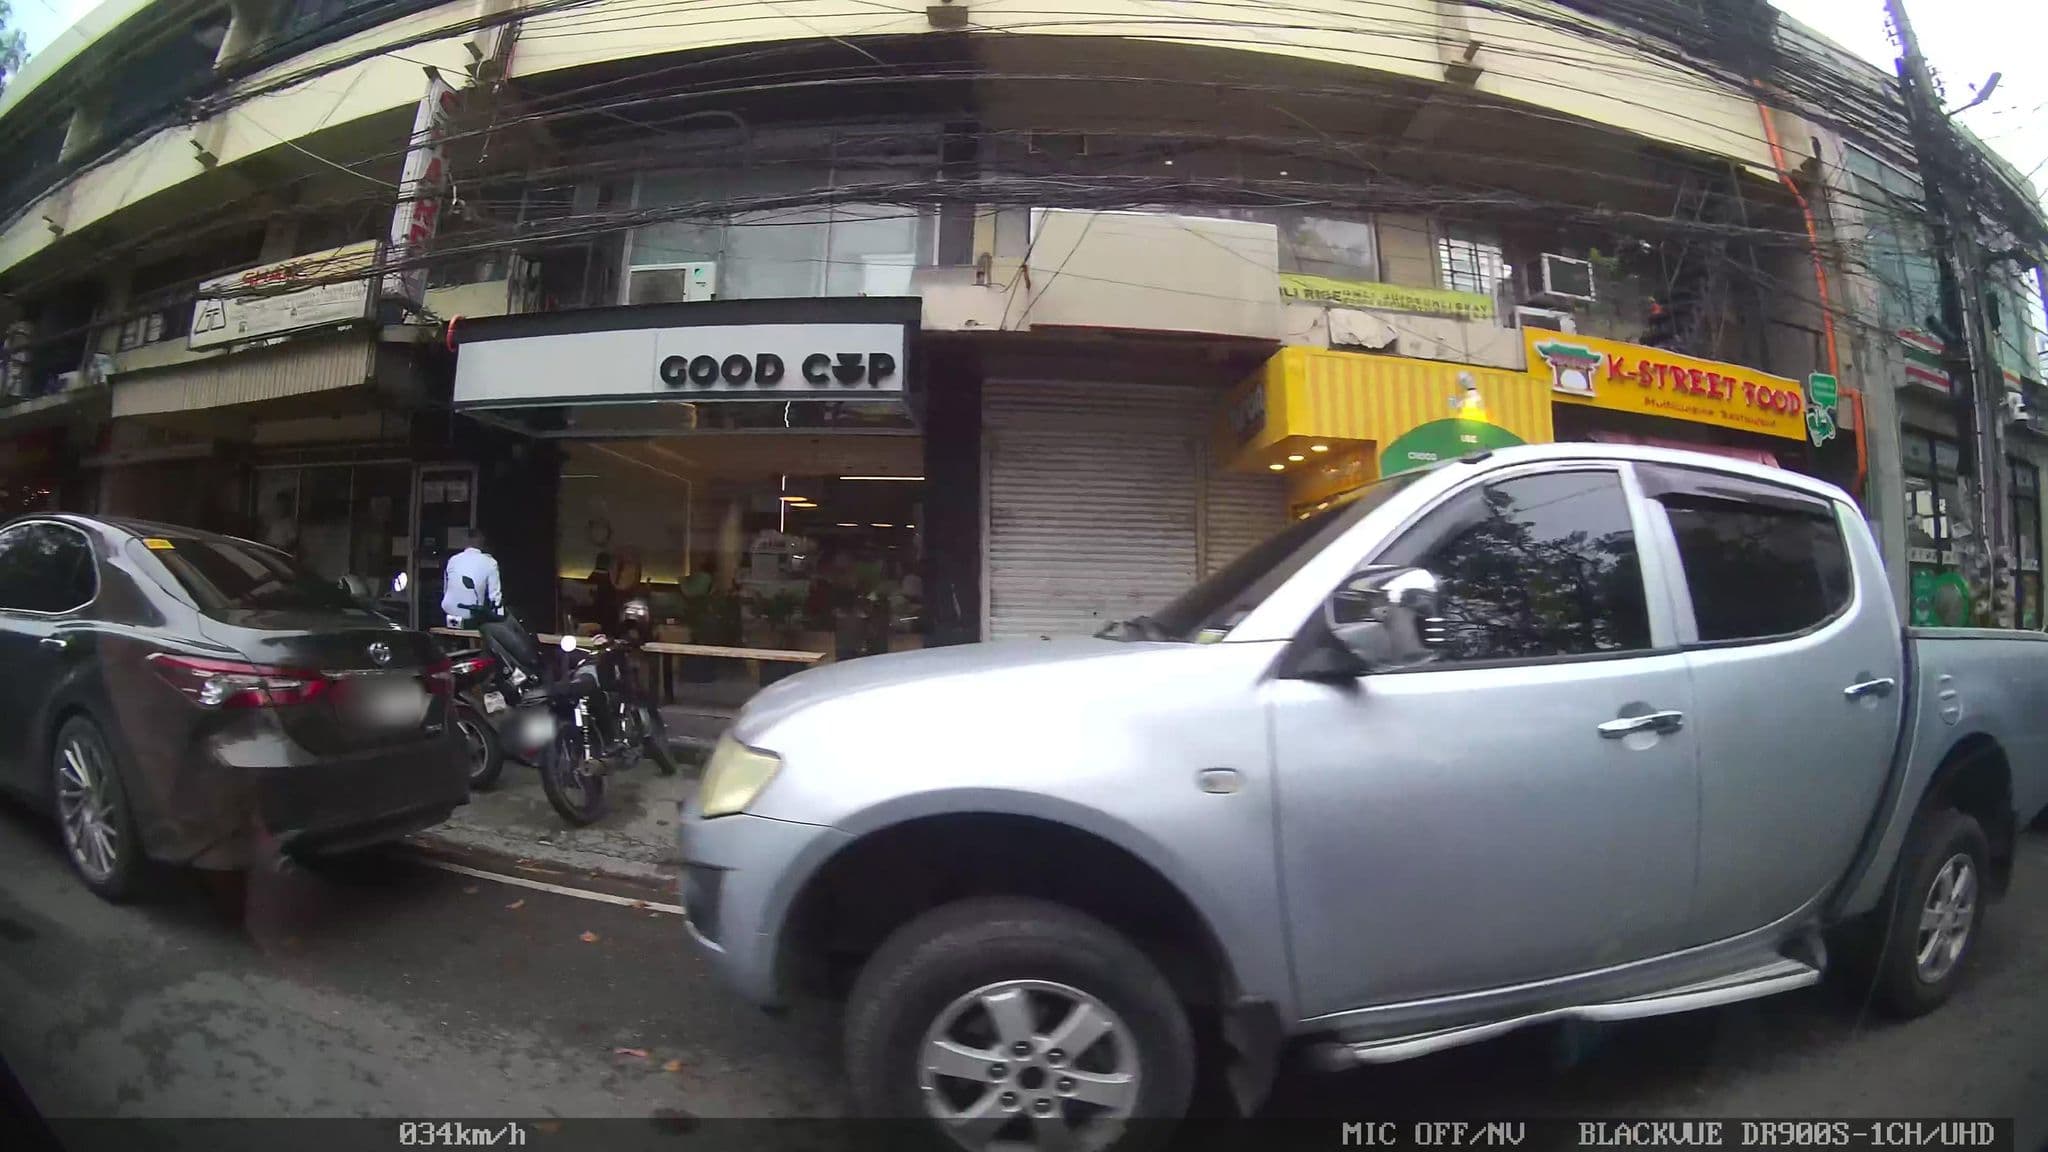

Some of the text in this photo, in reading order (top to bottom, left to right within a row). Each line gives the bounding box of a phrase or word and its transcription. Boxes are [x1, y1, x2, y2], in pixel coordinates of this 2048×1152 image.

[659, 354, 785, 387] GOOD
[1607, 353, 1801, 417] K-STREET FOOD
